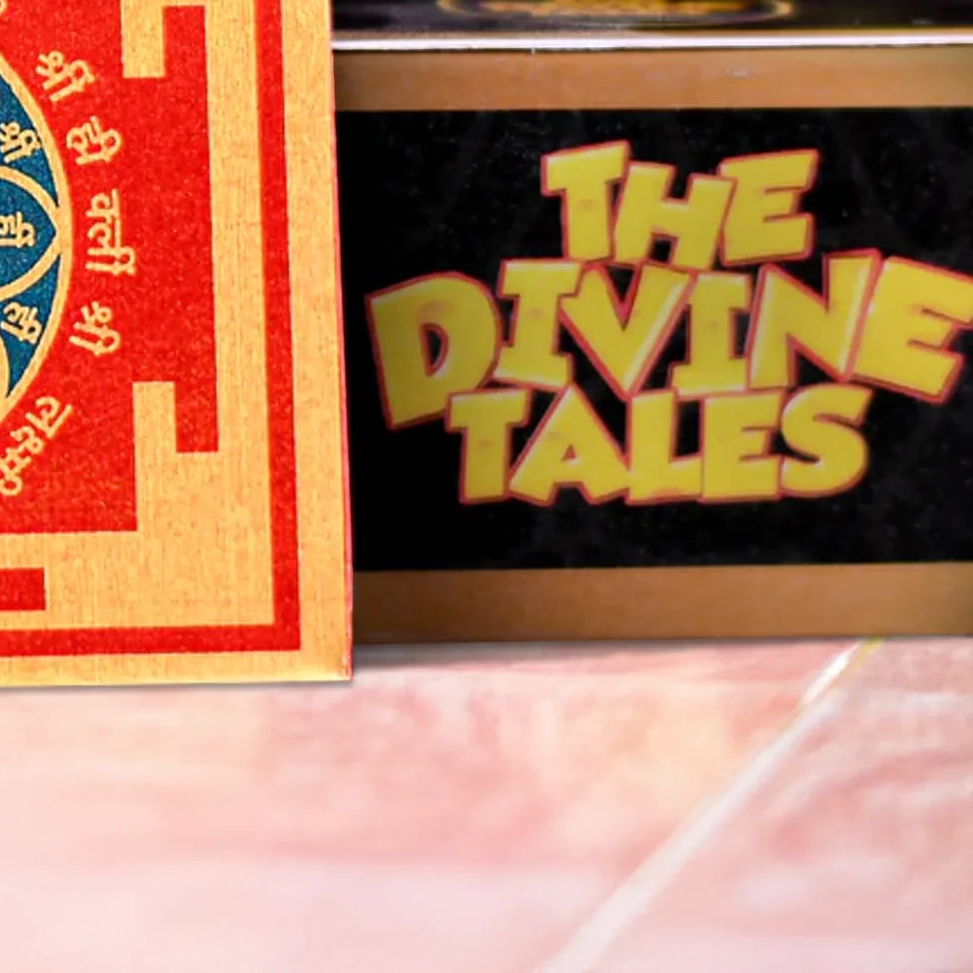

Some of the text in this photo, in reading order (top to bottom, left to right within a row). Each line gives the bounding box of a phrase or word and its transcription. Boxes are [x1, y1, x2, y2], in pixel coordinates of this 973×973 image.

[541, 140, 819, 269] THE
[365, 248, 973, 432] DIVINE
[444, 381, 874, 507] TALES
